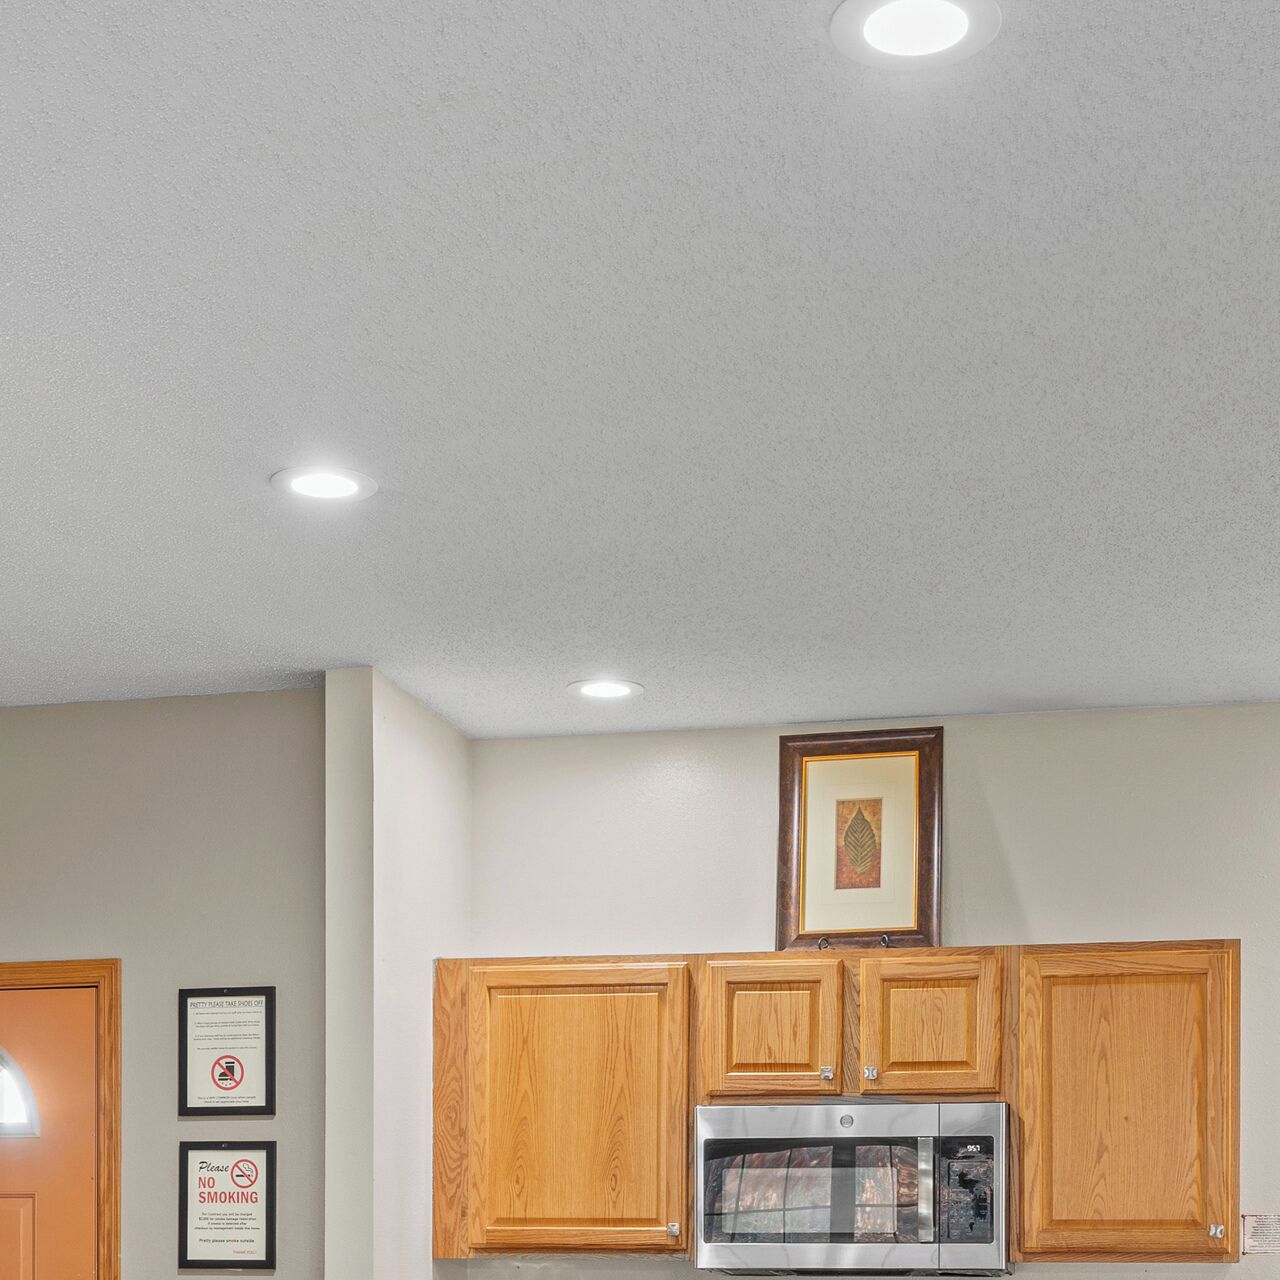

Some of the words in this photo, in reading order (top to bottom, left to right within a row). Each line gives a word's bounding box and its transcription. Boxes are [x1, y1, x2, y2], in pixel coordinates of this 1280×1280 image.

[198, 1160, 229, 1172] Please
[198, 1176, 215, 1188] NO
[198, 1191, 258, 1204] SMOKING
